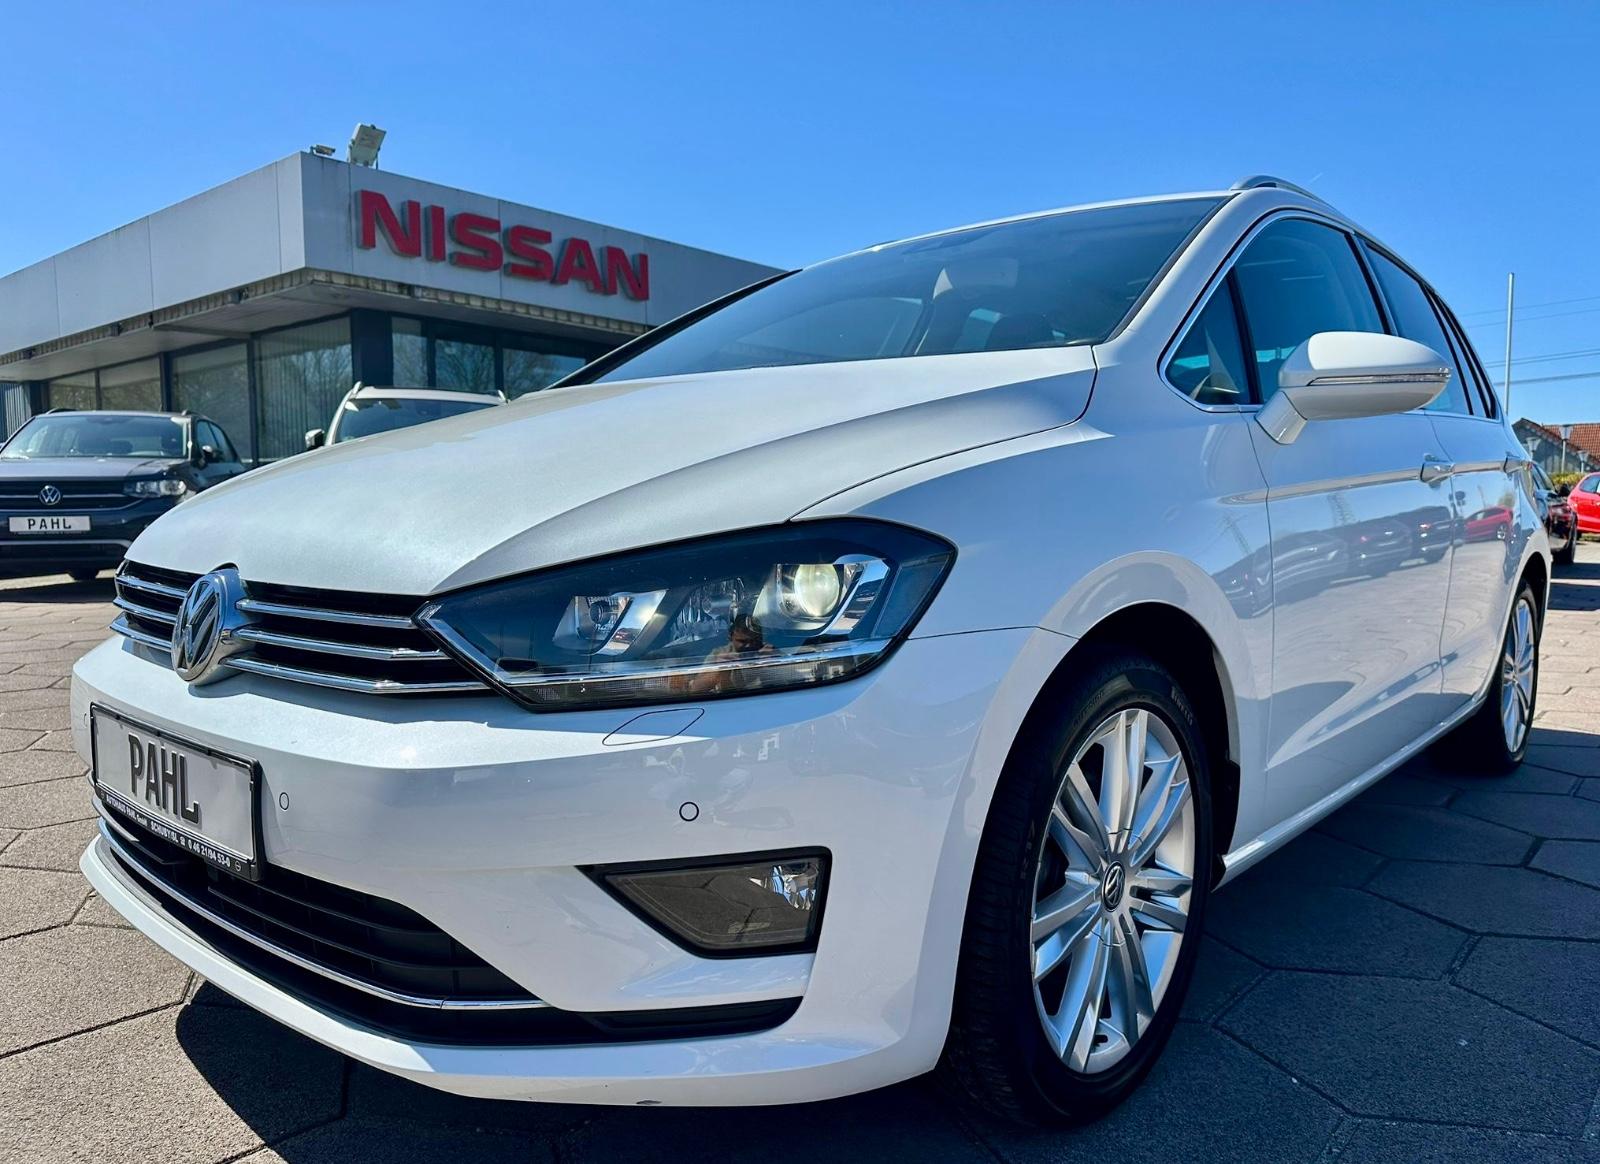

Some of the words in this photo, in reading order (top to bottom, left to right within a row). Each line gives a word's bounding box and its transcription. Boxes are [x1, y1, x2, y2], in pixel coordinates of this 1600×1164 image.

[356, 189, 650, 301] NISSAN
[27, 518, 72, 530] PAHL
[128, 732, 199, 824] PAHL
